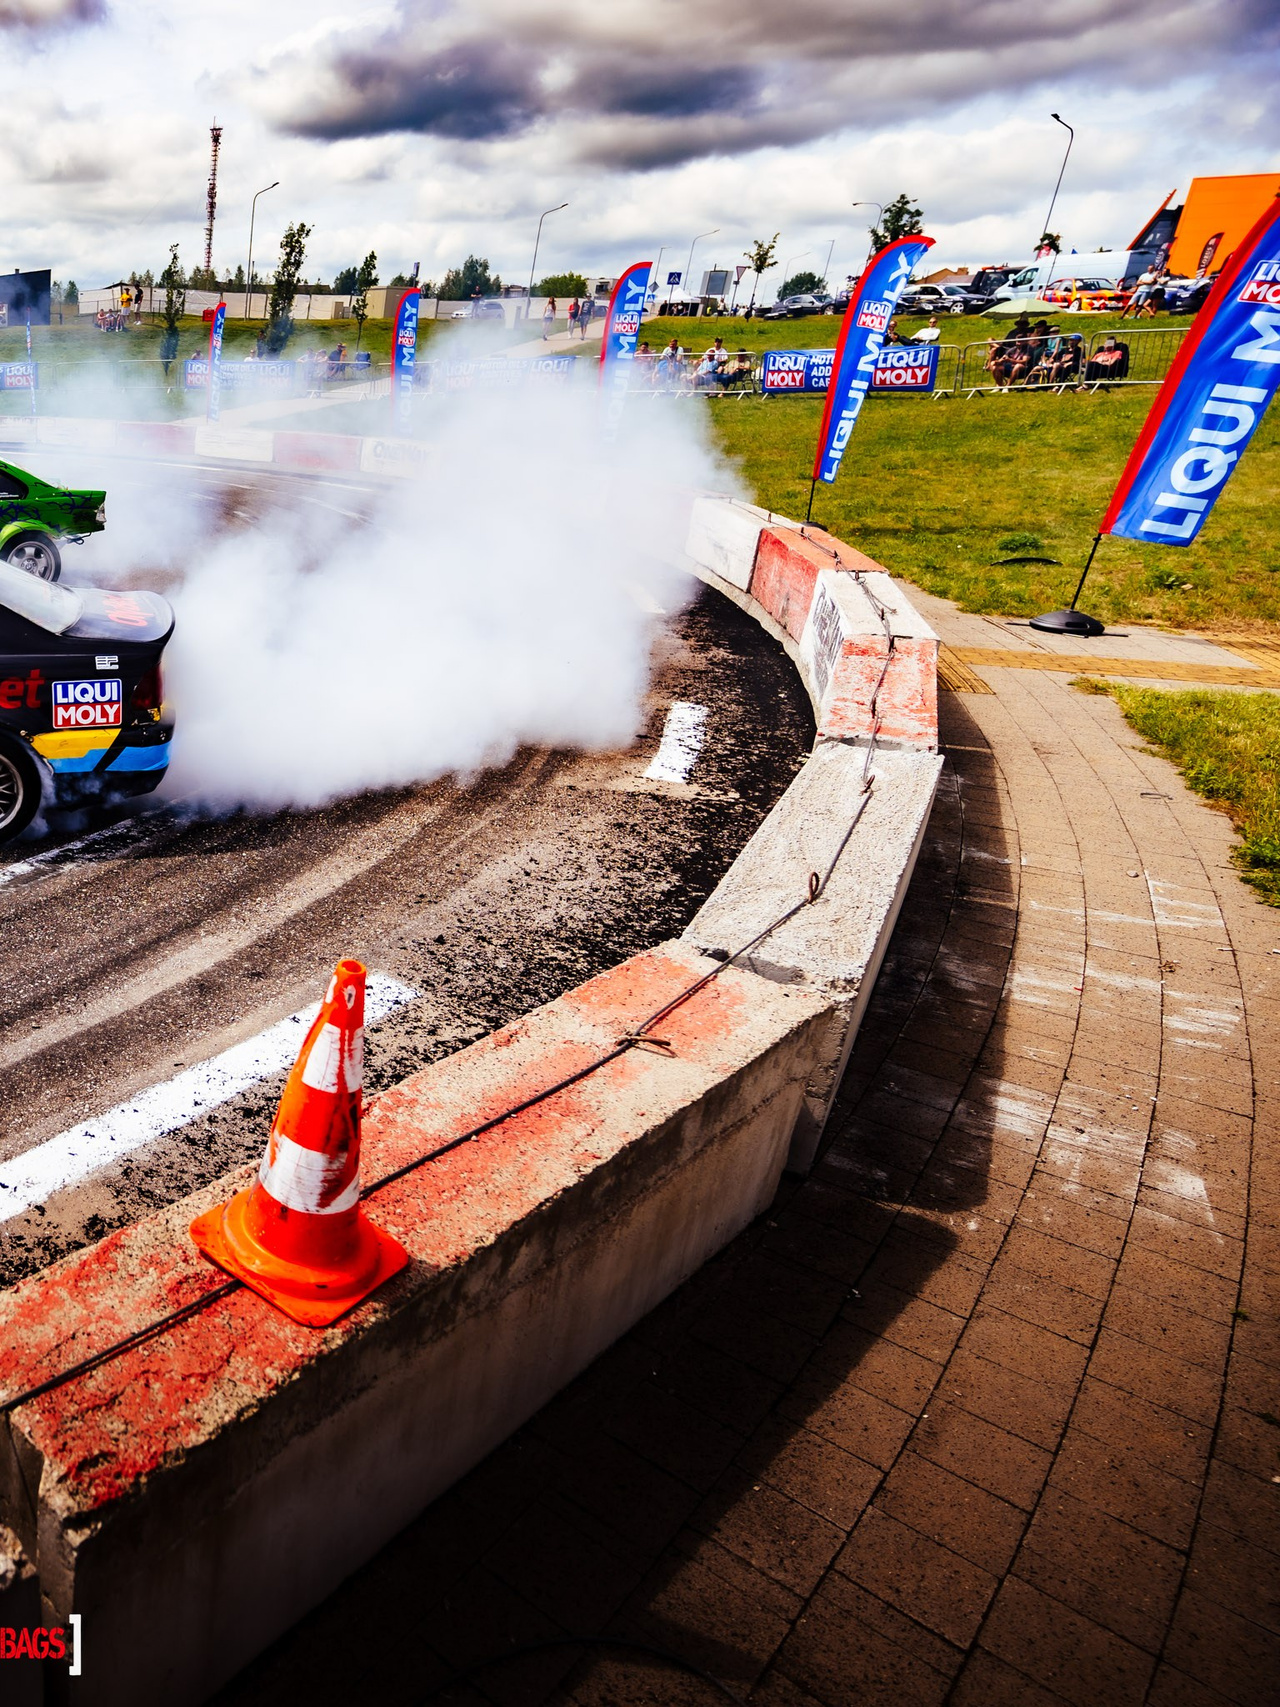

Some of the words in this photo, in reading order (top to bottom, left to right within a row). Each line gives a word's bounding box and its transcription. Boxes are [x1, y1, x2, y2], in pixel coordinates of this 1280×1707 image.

[863, 302, 888, 316] LIQU
[616, 314, 638, 323] LIQUI
[614, 323, 637, 332] MOLY
[769, 356, 807, 371] LIQUI
[810, 355, 835, 365] MOT
[878, 350, 929, 367] LIQUI
[188, 364, 209, 373] LIQU
[531, 360, 569, 373] LIQUI
[767, 371, 804, 387] MOLY
[875, 368, 929, 385] MOLY
[824, 380, 869, 481] LIQUI
[1139, 383, 1269, 539] LIQUI
[56, 682, 118, 705] LIQUI
[57, 704, 120, 725] MOLY
